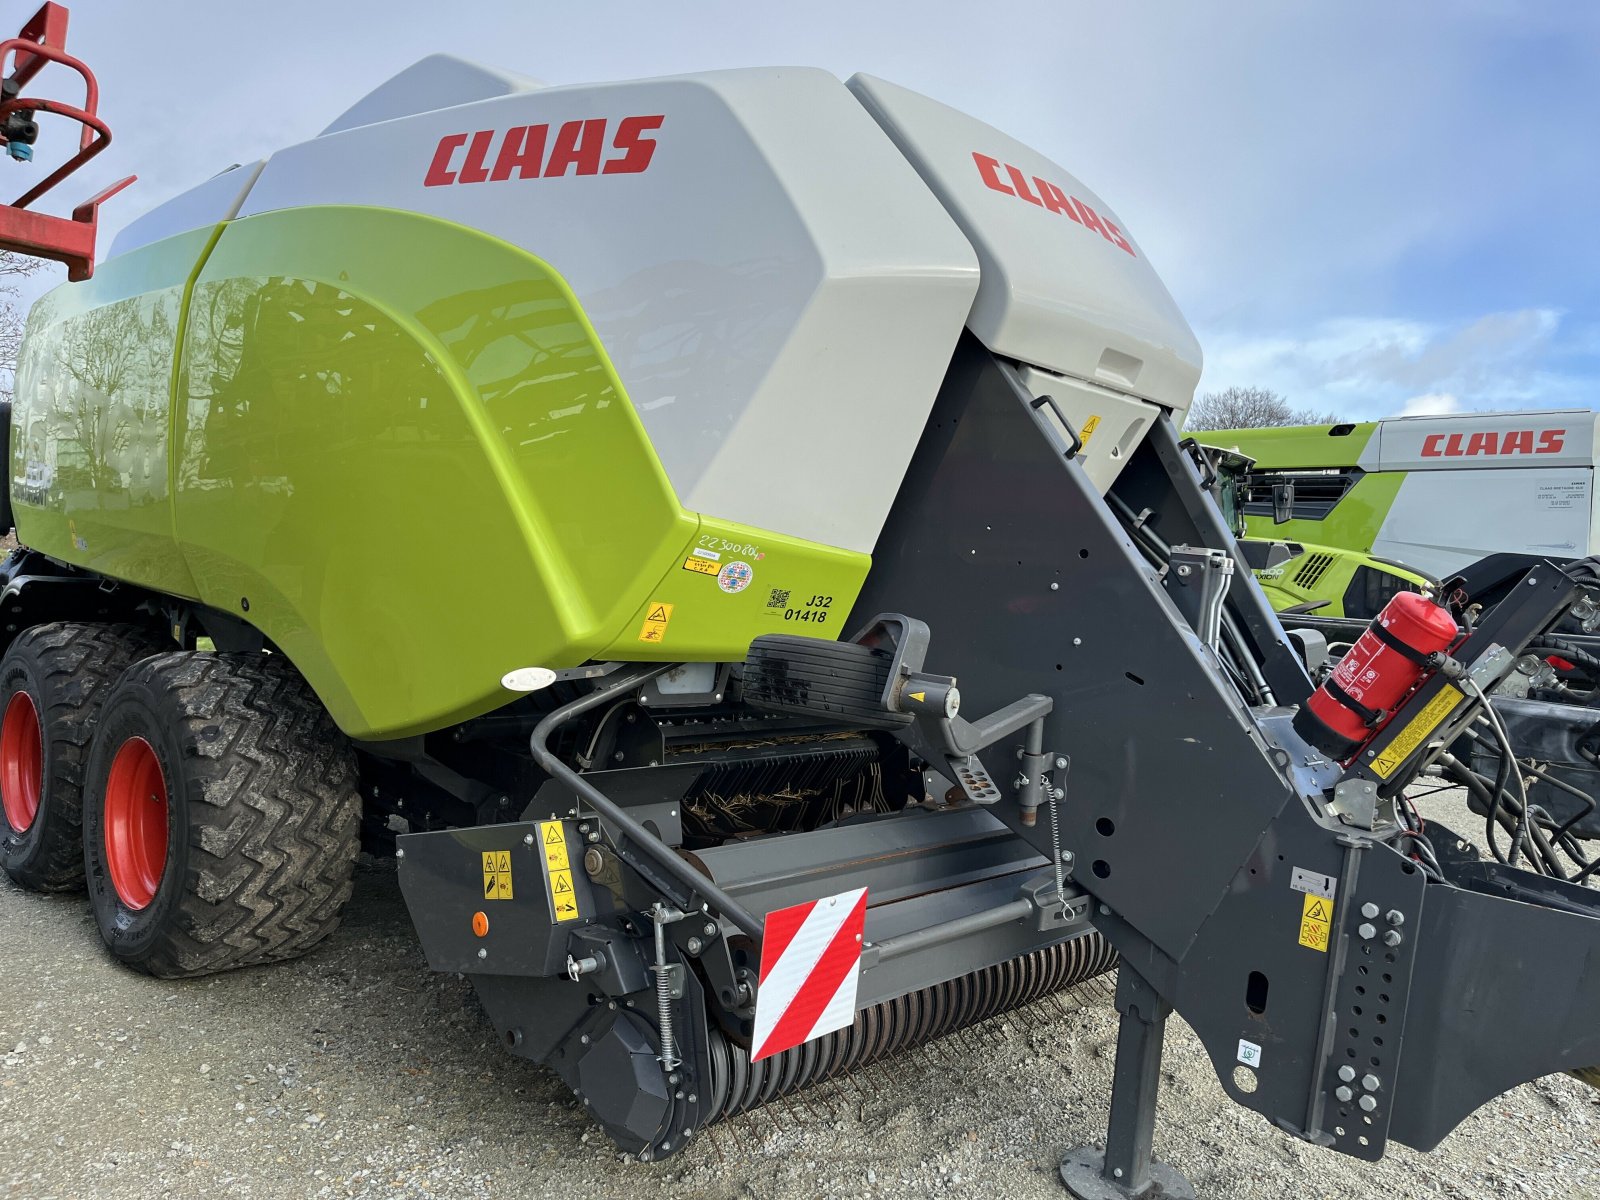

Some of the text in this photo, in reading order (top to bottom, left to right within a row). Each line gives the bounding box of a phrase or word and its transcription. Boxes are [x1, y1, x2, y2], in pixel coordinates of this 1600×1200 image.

[424, 114, 665, 188] CLAAS
[972, 152, 1136, 256] CLAAS
[1421, 428, 1565, 457] CLAAS
[784, 608, 827, 623] 01418
[806, 595, 833, 608] J32
